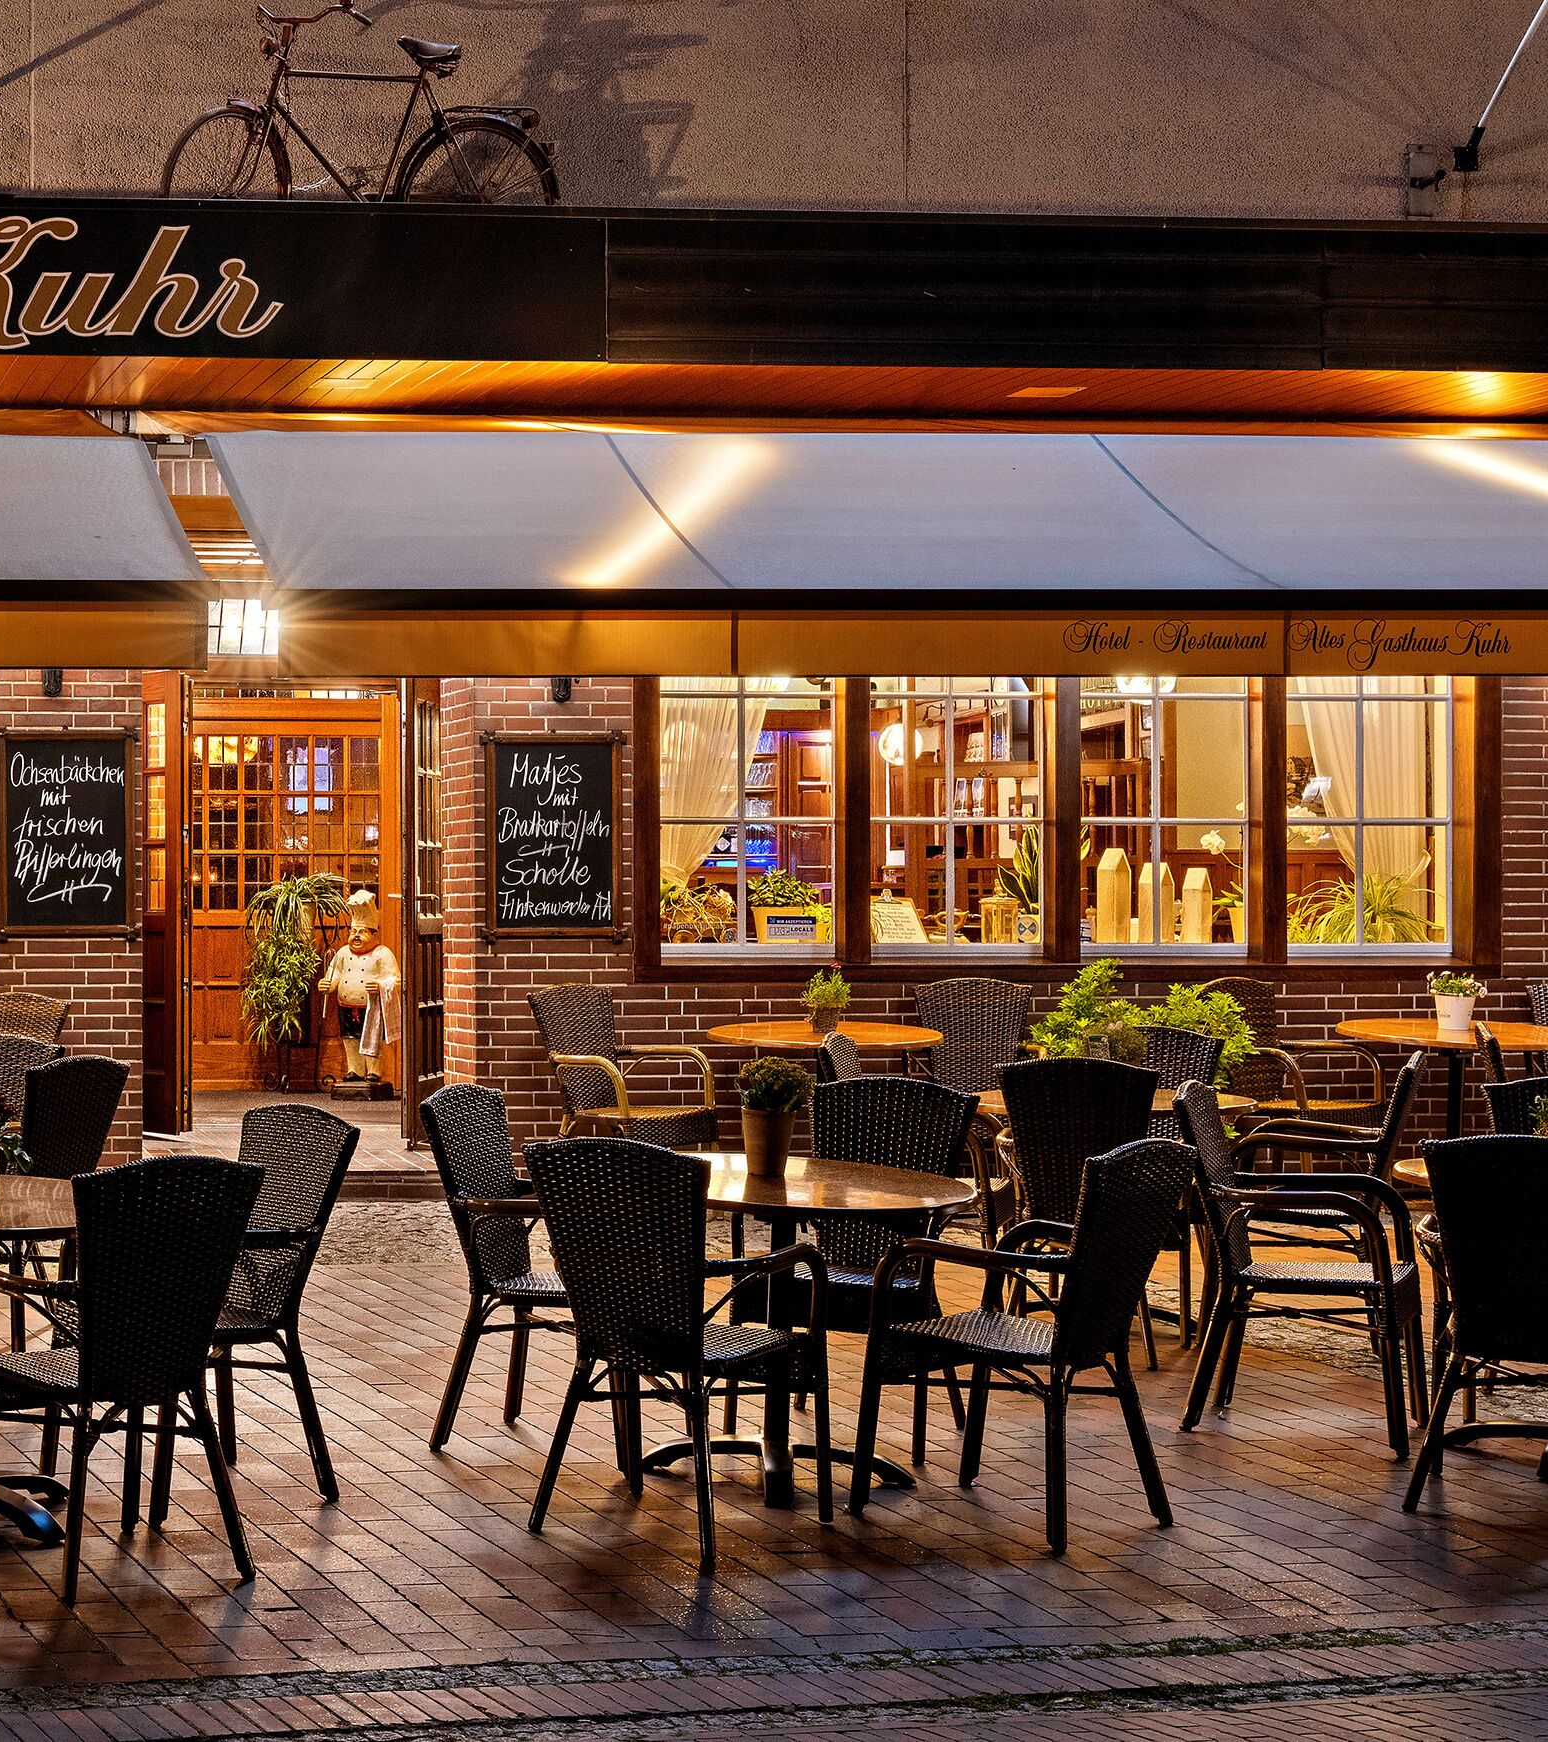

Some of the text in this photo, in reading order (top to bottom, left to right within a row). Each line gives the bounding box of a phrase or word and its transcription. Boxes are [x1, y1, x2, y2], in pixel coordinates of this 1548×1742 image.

[1063, 619, 1131, 654] Hotel
[1153, 618, 1268, 654] Restaurant
[1286, 618, 1346, 653] Altes
[1346, 618, 1450, 671] Gasthaus
[1447, 619, 1512, 657] Kuhr
[10, 751, 125, 787] Ochsenbäckchen
[509, 752, 583, 806] Matjes
[40, 785, 71, 807] mit
[552, 786, 579, 807] mit
[13, 806, 104, 855] frischen
[498, 806, 611, 851] Bratkartoffeln
[14, 838, 123, 887] Pfifferlingen
[502, 856, 592, 886] Scholle
